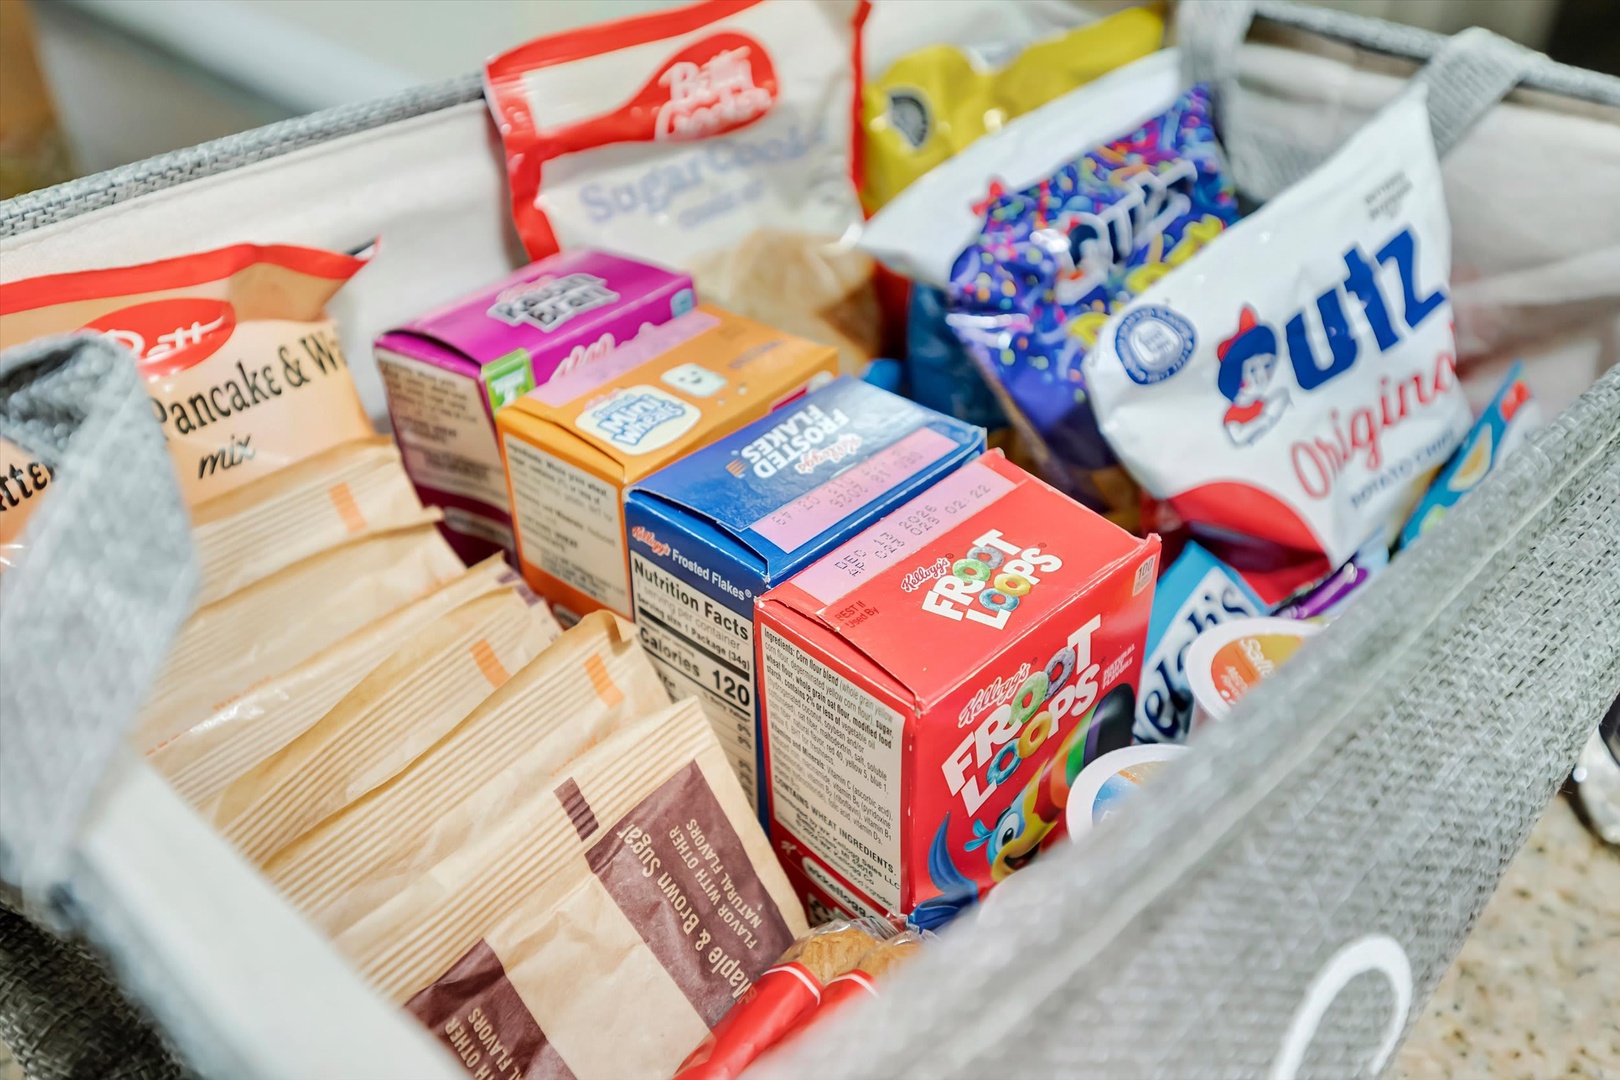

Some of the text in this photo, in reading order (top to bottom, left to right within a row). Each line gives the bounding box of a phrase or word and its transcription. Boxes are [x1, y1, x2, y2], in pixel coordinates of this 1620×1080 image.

[1286, 229, 1446, 390] utz
[278, 345, 311, 388] &
[198, 432, 256, 480] mix
[740, 404, 825, 465] FLAKES
[752, 408, 849, 479] FROSTED
[1290, 353, 1457, 499] Origina
[1350, 459, 1413, 508] POTATO
[631, 526, 671, 556] Kellogg's
[672, 548, 709, 580] Frosted
[832, 548, 868, 570] DEC
[901, 557, 951, 592] Kellogg's
[922, 529, 1022, 621] FROOT
[634, 558, 698, 612] Nutrition
[704, 600, 747, 641] Facts
[866, 605, 882, 621] By
[966, 546, 1063, 630] LOOPS
[691, 627, 725, 657] Package
[728, 649, 749, 671] (34g)
[695, 617, 739, 652] container
[764, 627, 794, 657] Ingredients:
[796, 648, 807, 666] Corn
[809, 658, 821, 675] flour
[823, 667, 838, 687] blend
[840, 679, 857, 701] (whole
[640, 625, 699, 678] Calories
[712, 667, 749, 708] 120
[958, 663, 1031, 729] Kellogg's
[784, 678, 804, 700] contains
[806, 692, 814, 707] 2%
[823, 705, 833, 721] less
[835, 714, 839, 725] of
[842, 720, 866, 746] vegetable
[796, 674, 810, 693] whole
[812, 686, 825, 705] grain
[827, 697, 835, 710] oat
[837, 703, 850, 722] flour,
[852, 714, 876, 739] modified
[879, 732, 891, 749] food
[826, 683, 842, 705] yellow
[844, 697, 856, 713] corn
[876, 719, 892, 740] sugar,
[941, 614, 1102, 797] FROOT
[845, 755, 861, 777] yellow
[870, 772, 881, 789] blue
[847, 734, 863, 754] and/or
[867, 759, 886, 781] soluble
[960, 664, 1100, 817] LOOPS
[827, 764, 845, 786] Vitamin
[852, 784, 876, 809] (ascorbic
[774, 773, 808, 809] CONTAINS
[811, 805, 836, 832] WHEAT
[839, 826, 895, 876] INGREDIENTS.
[864, 813, 882, 834] vitamin
[668, 825, 759, 951] FLAVOR WITH OTHER
[685, 818, 763, 929] NATURAL FLAVORS
[862, 857, 880, 877] Sales
[884, 874, 899, 891] LLC
[616, 823, 752, 999] Maple & Brown Sugar
[444, 1016, 482, 1069] OTHER
[466, 1006, 514, 1073] FLAVORS
